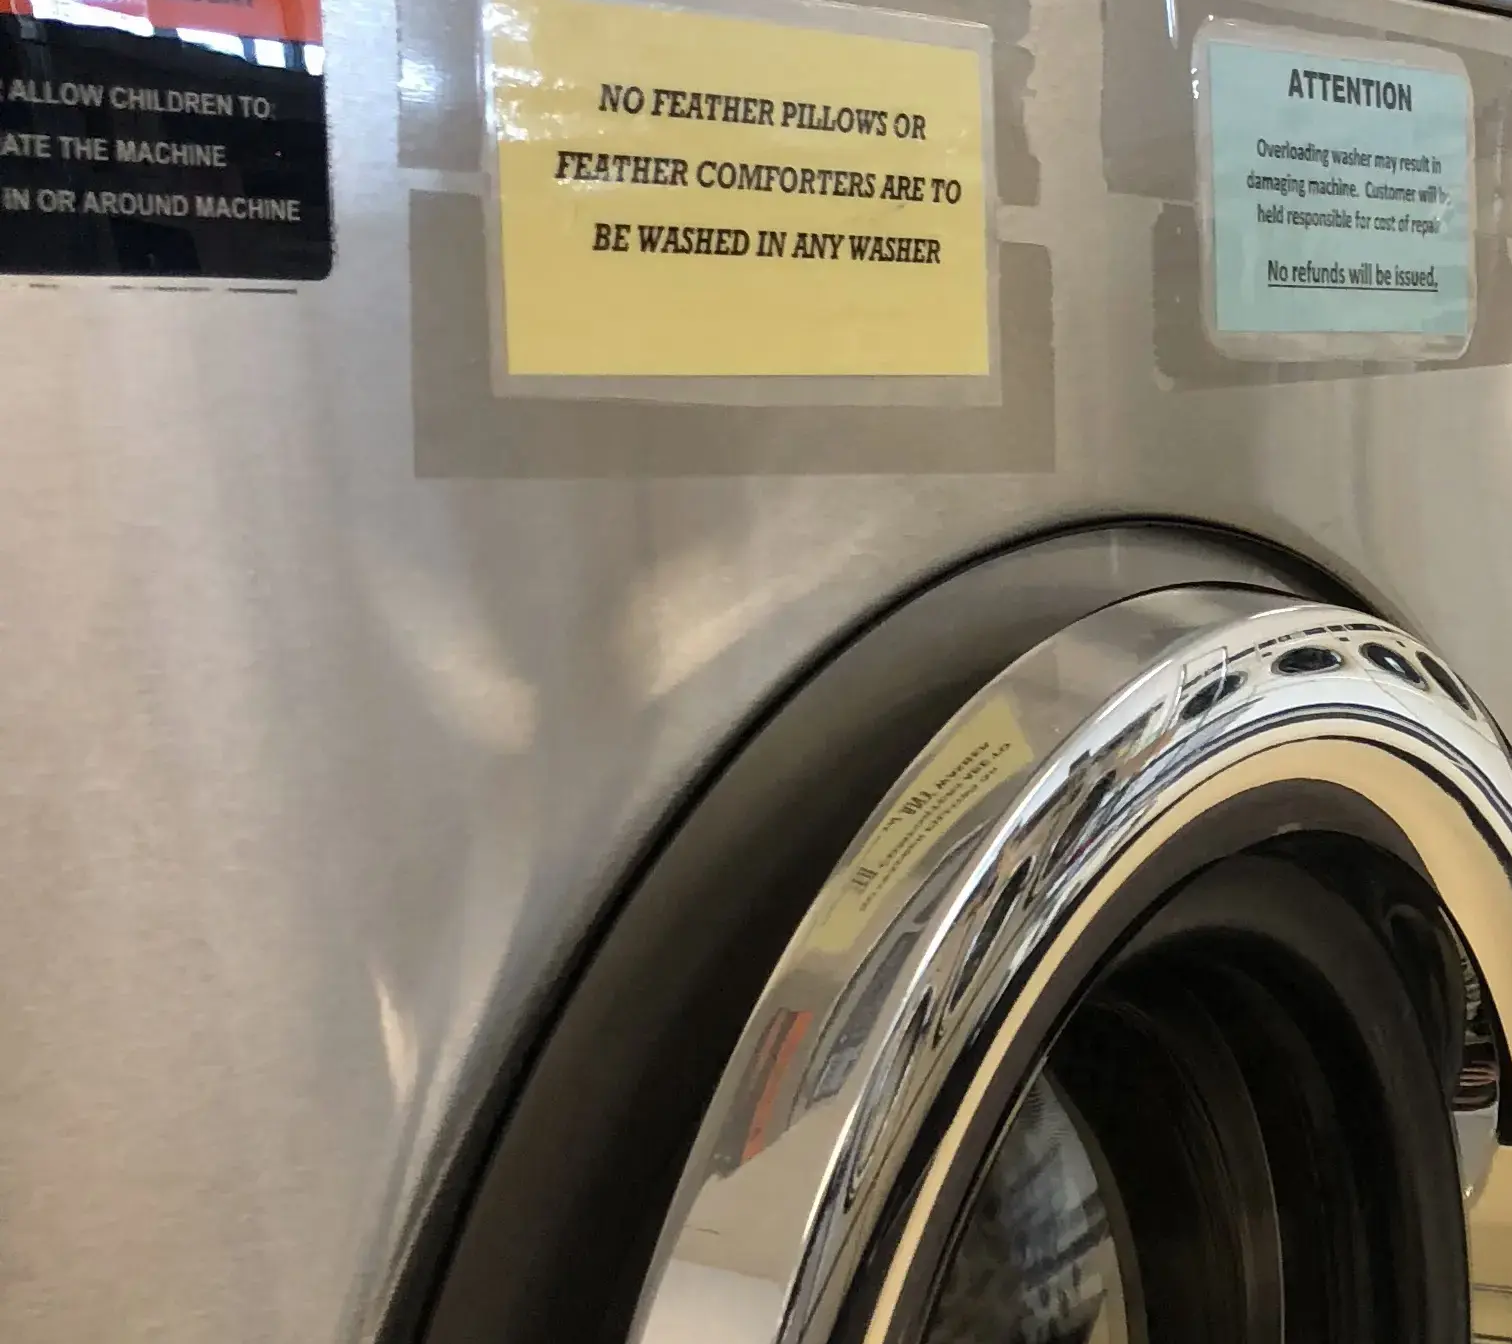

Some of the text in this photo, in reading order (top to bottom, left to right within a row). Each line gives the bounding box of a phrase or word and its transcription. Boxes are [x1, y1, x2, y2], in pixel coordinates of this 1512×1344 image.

[13, 80, 103, 107] ALLOW
[110, 85, 233, 117] CHILDREN
[1288, 68, 1412, 112] ATTENTION
[599, 84, 926, 141] NO FEATHER PILLOWS OR
[59, 136, 108, 161] THE
[116, 141, 227, 168] MACHINE
[1257, 139, 1442, 174] Overloading washer may result in
[555, 151, 962, 204] FEATHER COMFORTERS ARE TO
[1247, 170, 1437, 203] damaging machine. Customer will
[5, 188, 301, 222] IN OR AROUND MACHINE
[1257, 204, 1410, 233] held responsible for cost of
[593, 222, 941, 265] BE WASHED IN ANY WASHER
[1267, 260, 1438, 288] No refunds will be issued.
